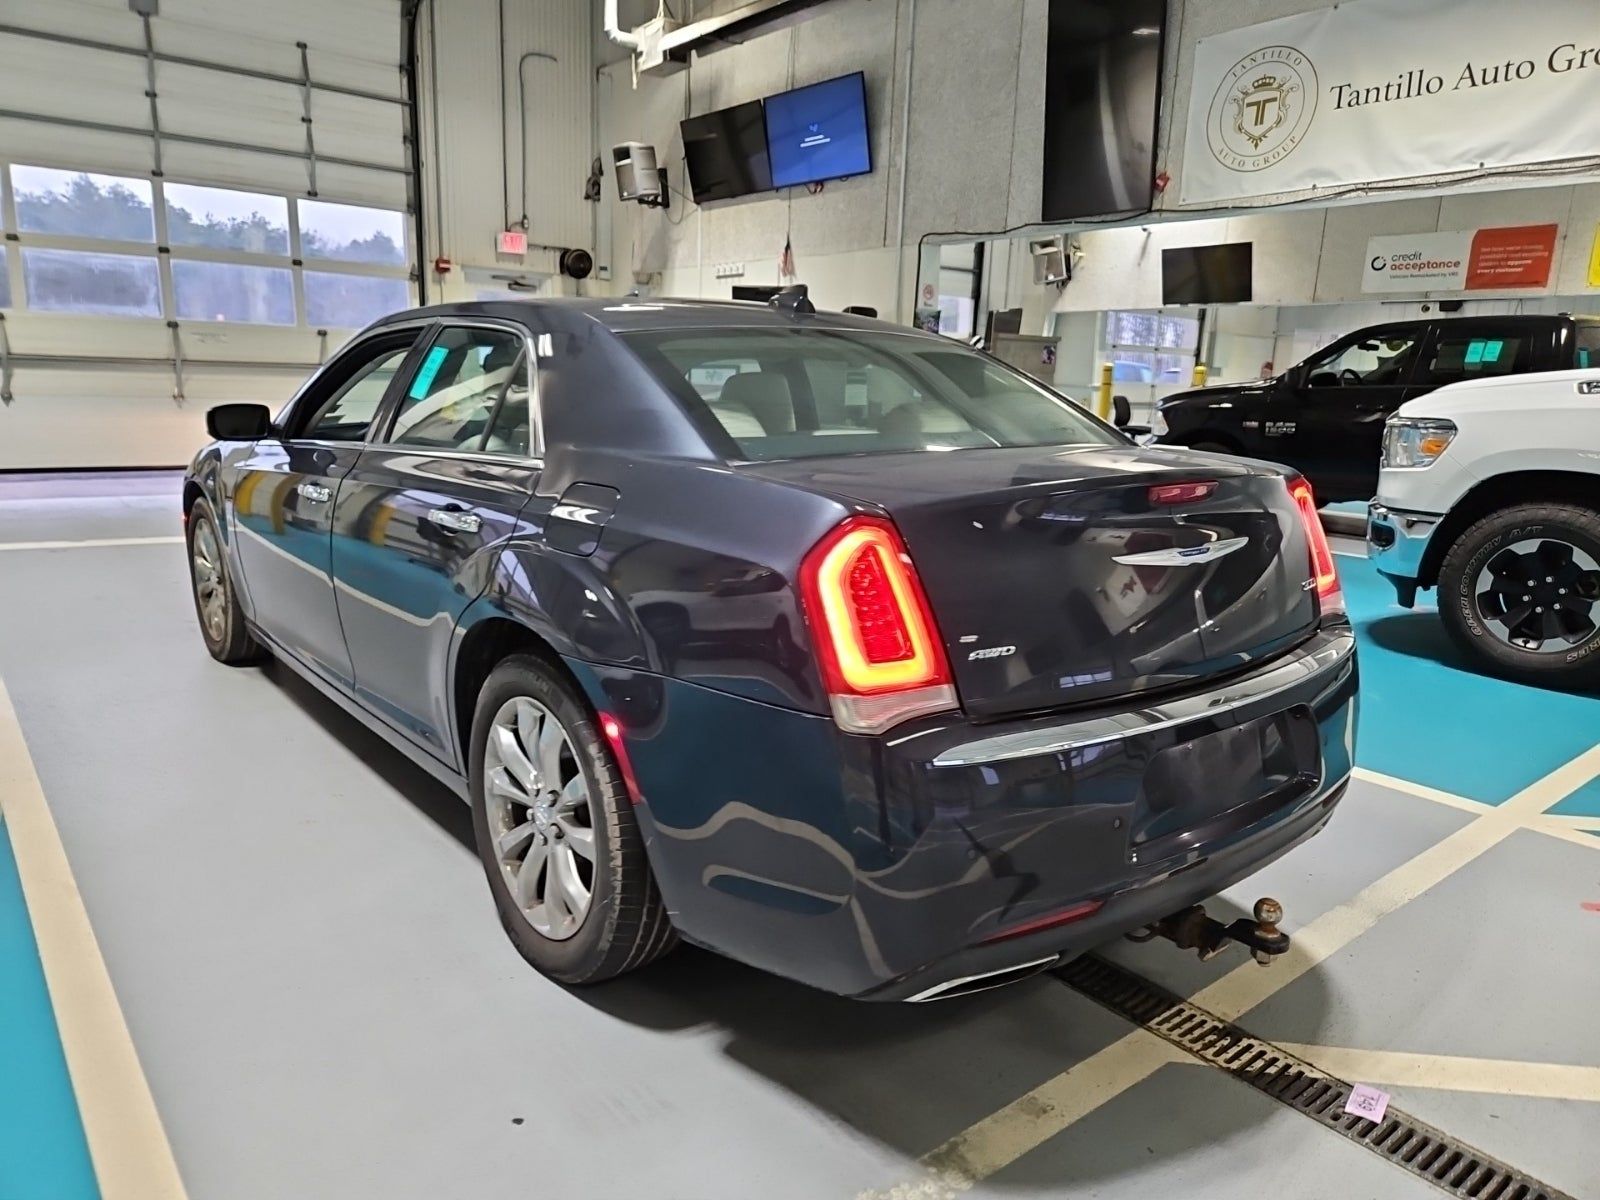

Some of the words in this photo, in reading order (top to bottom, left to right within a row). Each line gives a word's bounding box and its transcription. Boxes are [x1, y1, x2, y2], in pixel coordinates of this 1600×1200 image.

[1231, 50, 1302, 78] TANTILLO
[1329, 69, 1444, 111] Tantillo
[1451, 58, 1536, 91] Auto
[1218, 147, 1246, 168] AUTO
[1252, 135, 1298, 168] GROUP
[1390, 260, 1461, 272] acceptance
[1391, 251, 1423, 262] credit
